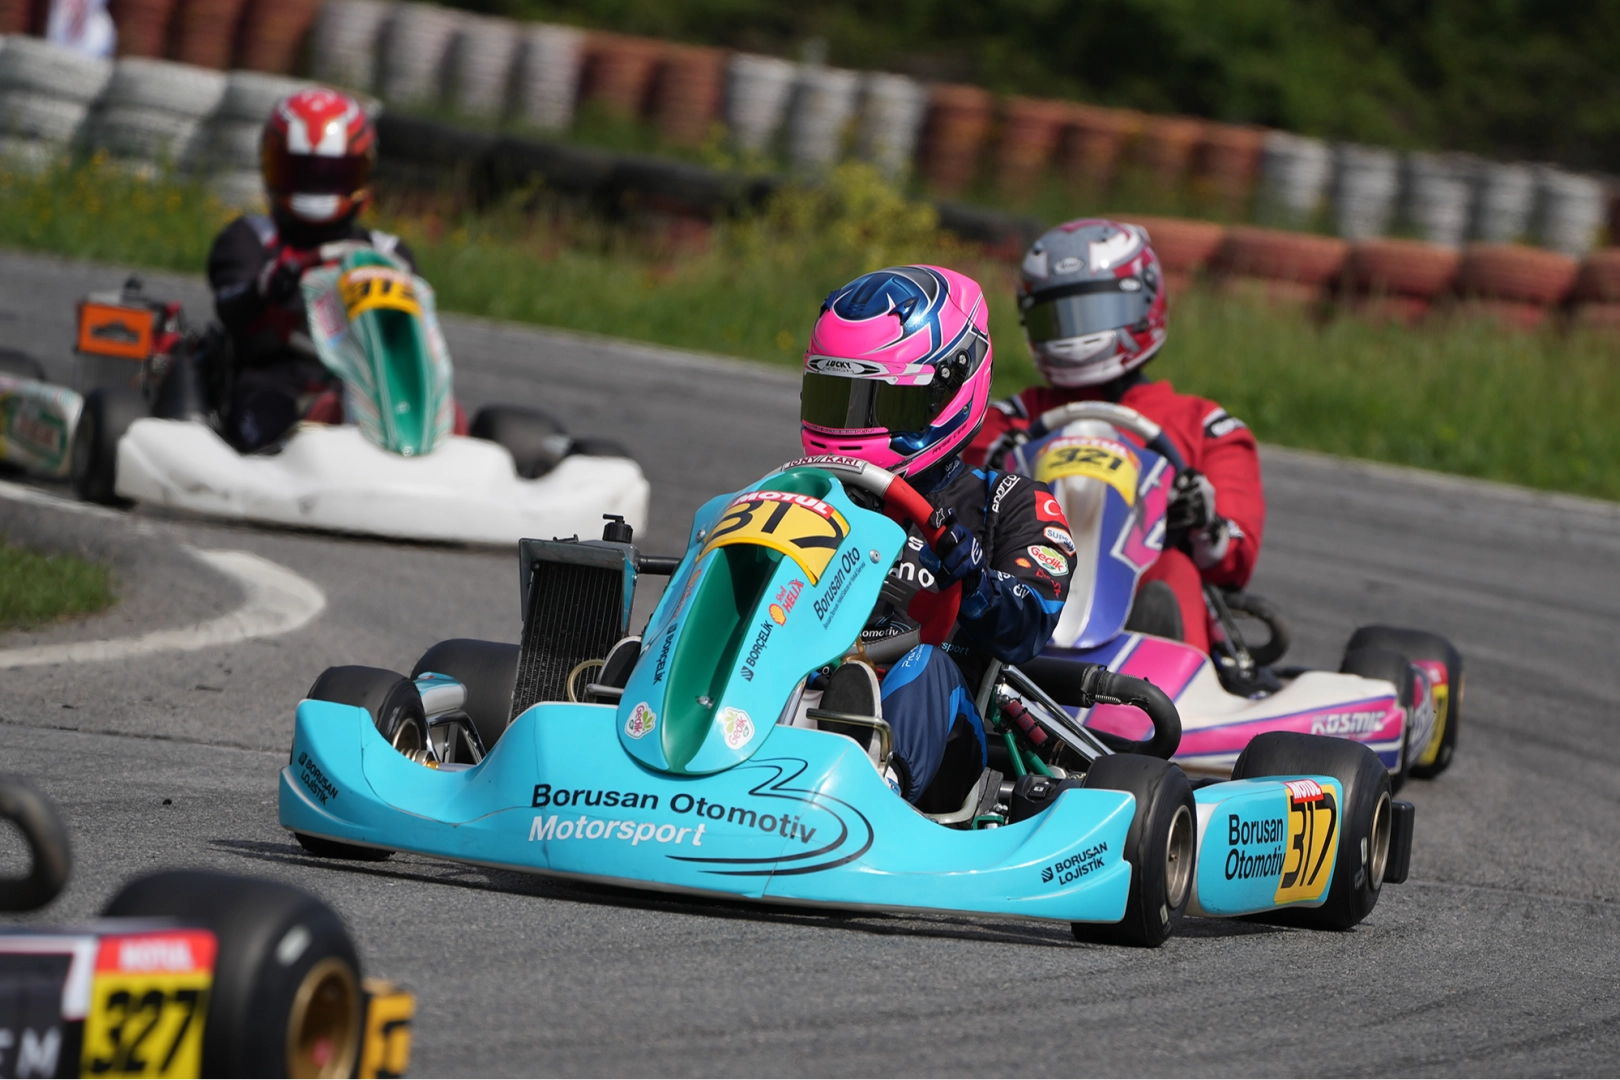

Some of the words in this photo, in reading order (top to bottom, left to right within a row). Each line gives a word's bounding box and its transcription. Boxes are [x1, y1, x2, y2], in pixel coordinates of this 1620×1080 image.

[825, 359, 851, 369] LUCKY
[732, 492, 830, 515] MOTUL
[707, 500, 844, 550] 317
[1031, 546, 1065, 572] Gedik
[782, 578, 805, 613] HELIX
[813, 568, 846, 621] Borusan
[842, 547, 860, 574] Oto
[746, 620, 774, 667] BORÇELİK
[860, 626, 899, 637] omotiv
[938, 641, 969, 655] sport
[634, 705, 645, 734] Gedik
[729, 717, 747, 746] Gedik
[305, 759, 339, 799] BORUSAN
[1286, 780, 1322, 799] MOTUL
[531, 783, 659, 809] Borusan
[669, 793, 817, 844] Otomotiv
[1228, 813, 1284, 846] Borusan
[528, 815, 707, 846] Motorsport
[1281, 793, 1337, 888] 317
[1055, 841, 1108, 874] BORUSAN
[91, 987, 203, 1075] 327
